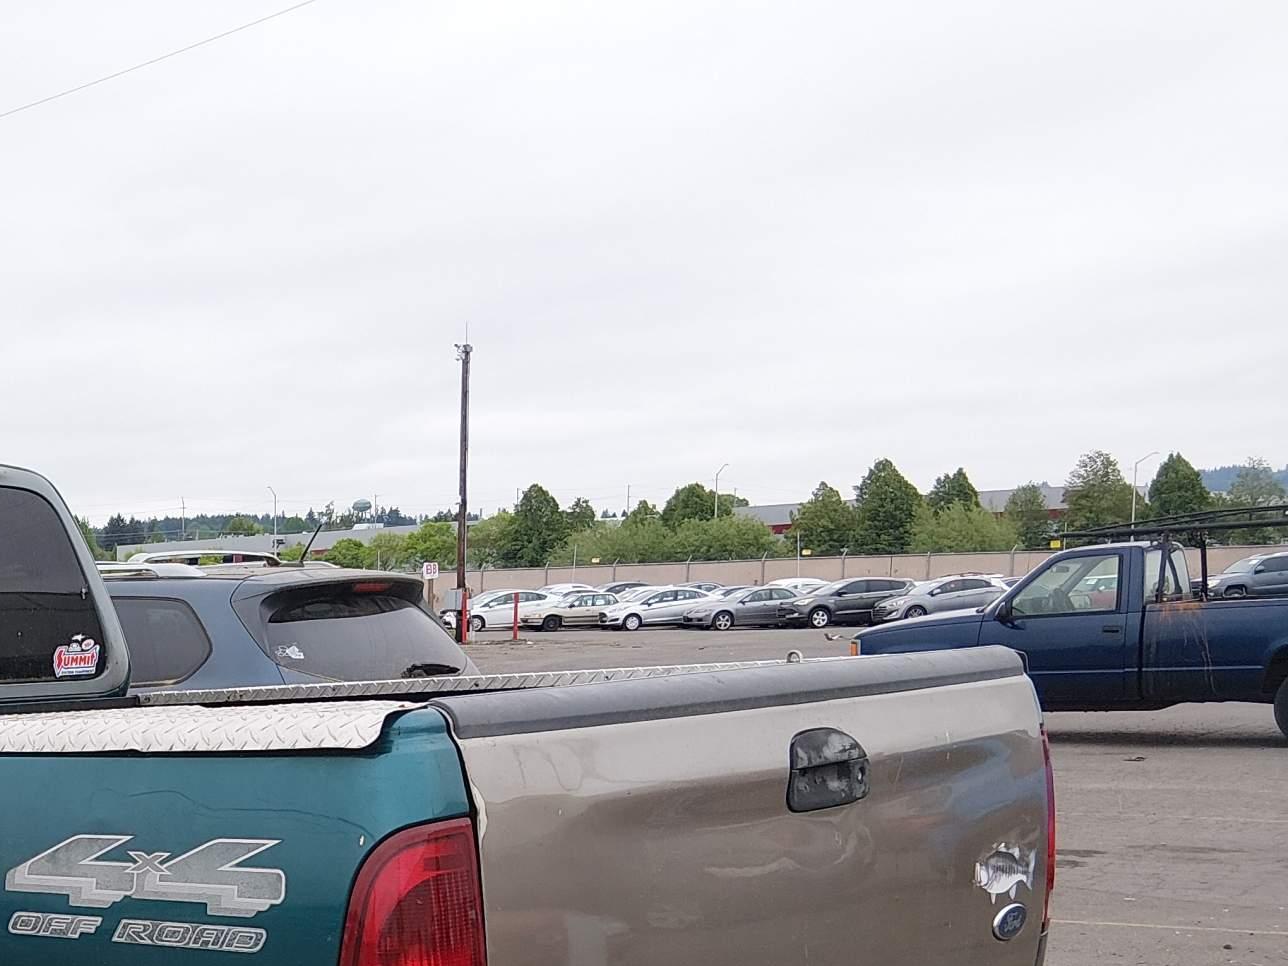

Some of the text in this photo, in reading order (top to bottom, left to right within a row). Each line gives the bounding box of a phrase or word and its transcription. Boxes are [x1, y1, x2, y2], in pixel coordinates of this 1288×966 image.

[55, 648, 96, 670] SUMMIT
[8, 911, 268, 954] OFF ROAD
